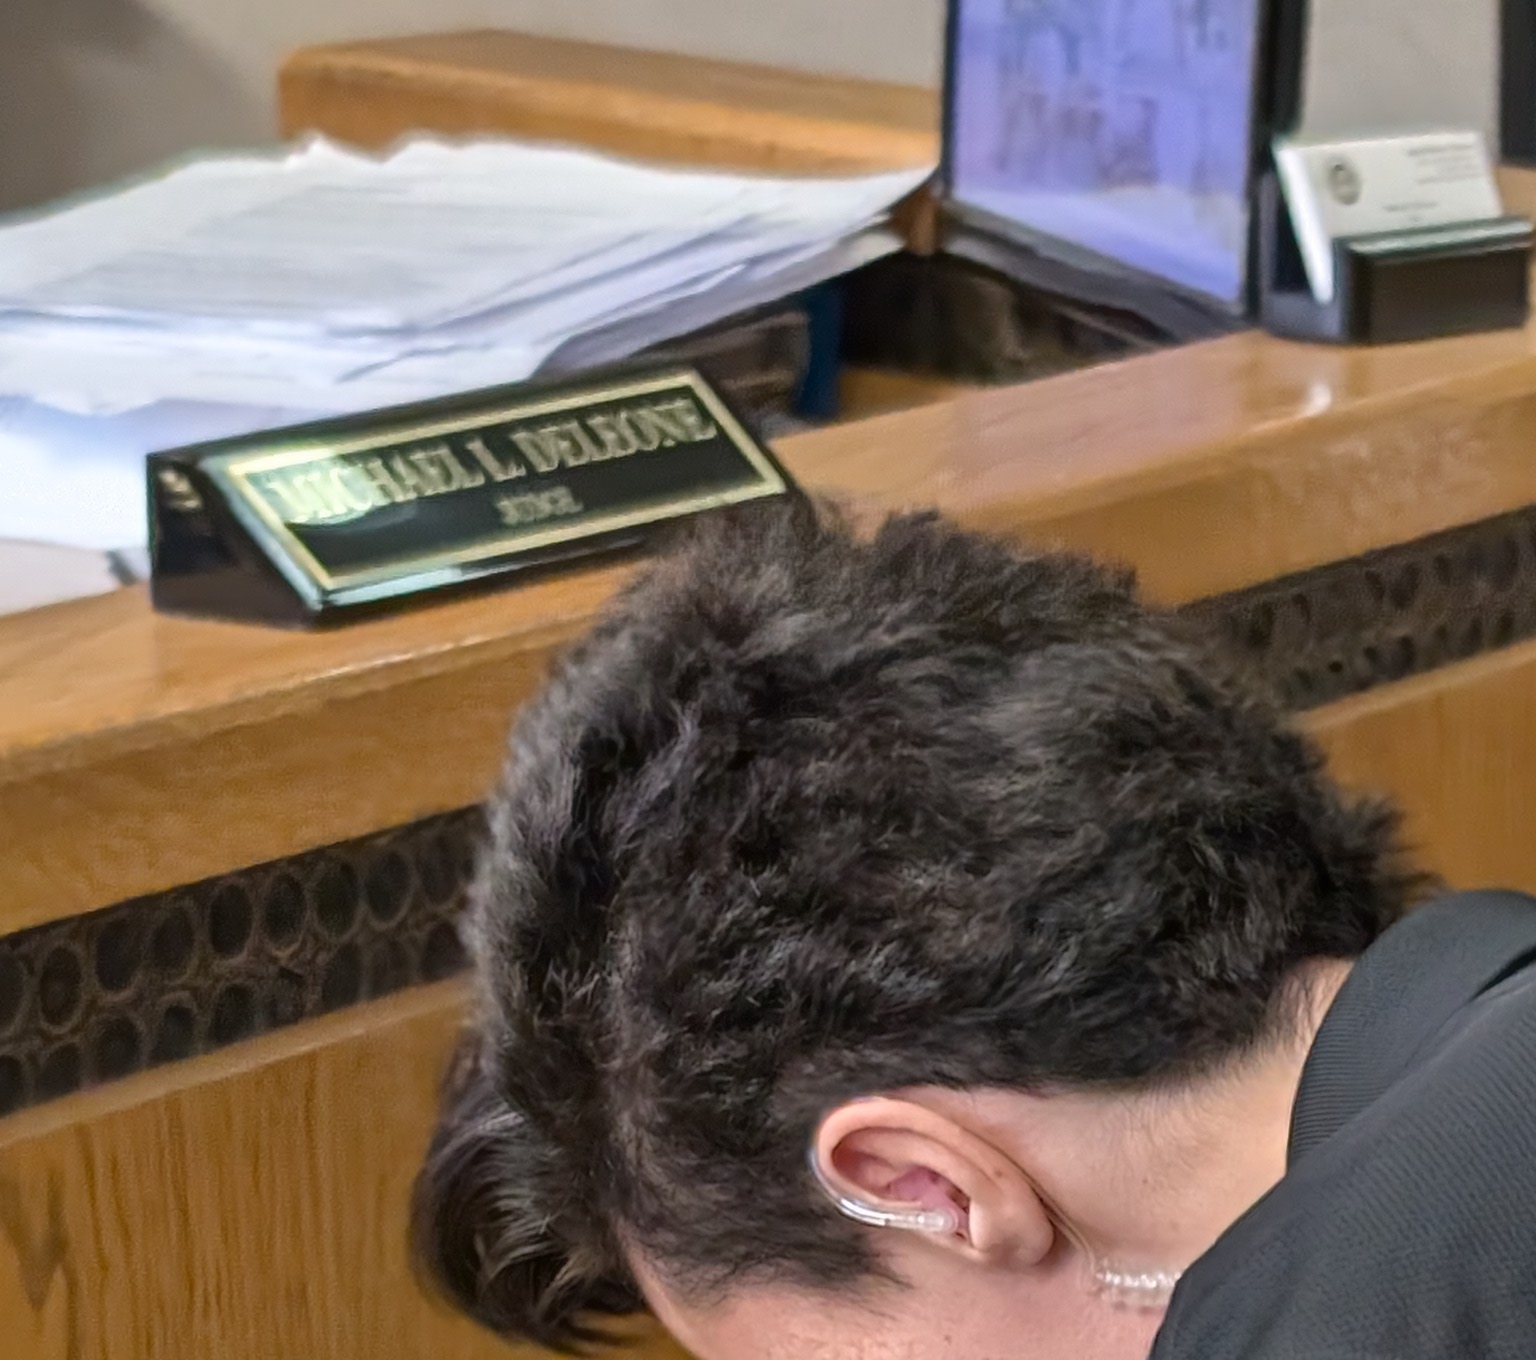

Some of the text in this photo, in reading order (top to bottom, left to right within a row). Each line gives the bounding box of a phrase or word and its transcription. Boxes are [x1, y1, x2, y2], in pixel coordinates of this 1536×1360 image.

[265, 398, 718, 523] MICHAEL L. DELEONE
